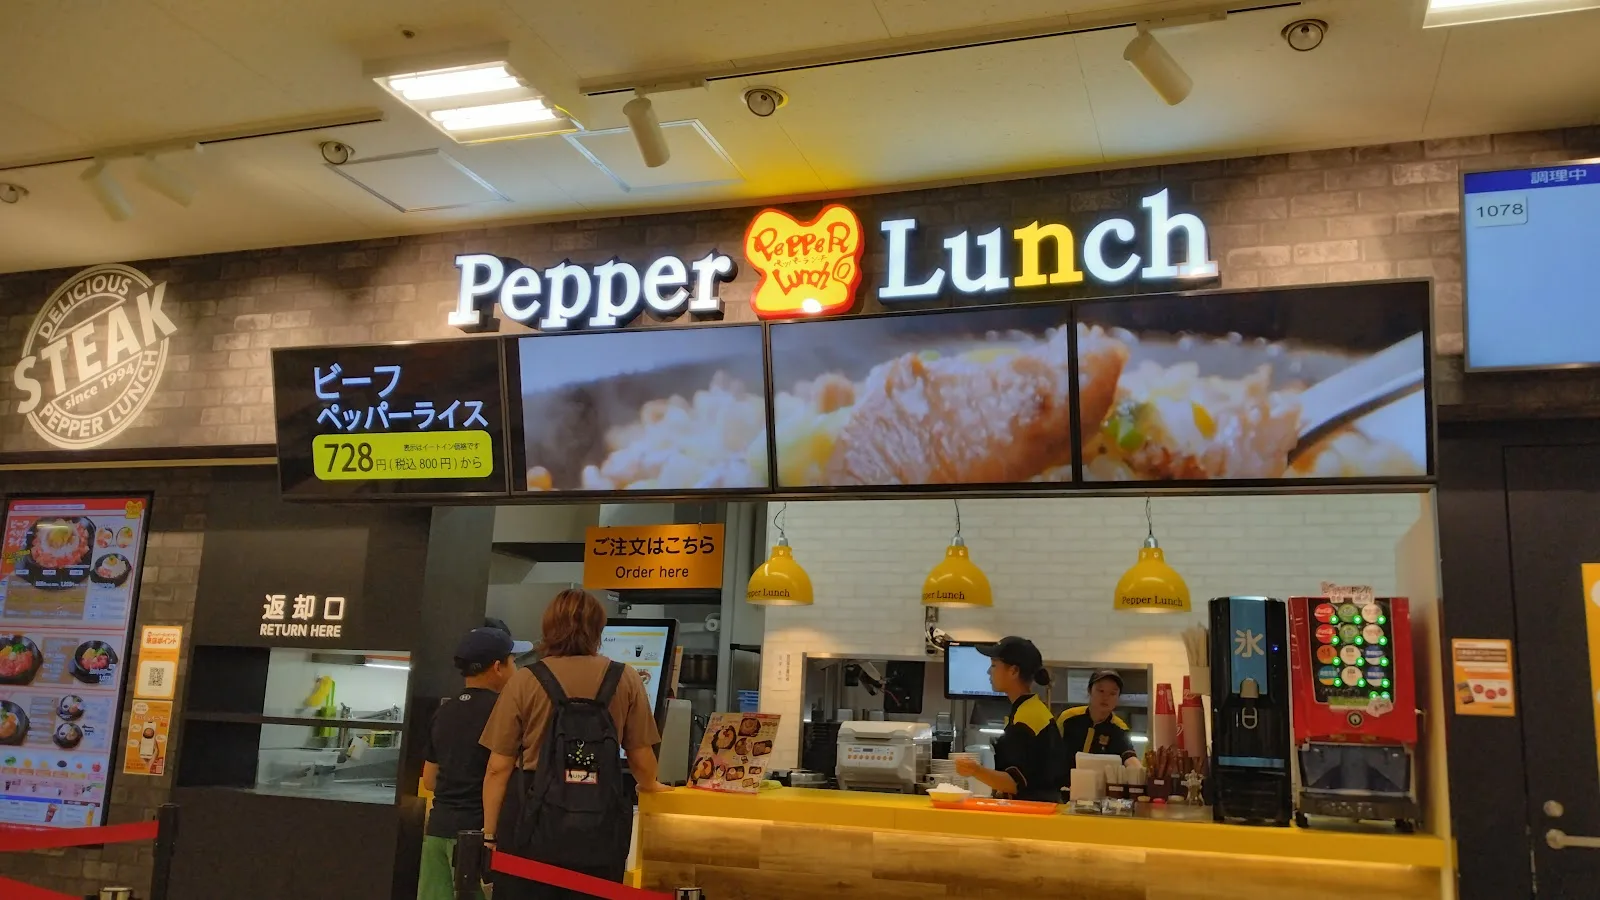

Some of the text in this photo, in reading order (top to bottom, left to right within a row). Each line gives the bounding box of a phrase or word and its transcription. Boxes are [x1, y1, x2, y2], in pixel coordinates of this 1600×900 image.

[1530, 168, 1587, 184] 調理中
[1475, 203, 1524, 218] 1078
[448, 187, 1219, 328] Pepper Lunch
[38, 274, 132, 340] DELICIOUS
[14, 280, 178, 414] STEAK
[65, 362, 135, 410] since 1994
[314, 362, 401, 399] ビーフ
[38, 350, 158, 437] PEPPER LUNCH
[316, 399, 489, 431] ペッパーライス
[403, 442, 480, 452] 表示はイートイン価格です
[593, 536, 715, 556] ご注文はこちら
[615, 566, 689, 579] Order here
[763, 588, 790, 598] Lunch
[937, 590, 965, 600] Lunch
[1122, 595, 1182, 606] Pepper Lunch
[261, 593, 345, 621] 返却口
[260, 623, 341, 637] RETURN HERE
[1234, 628, 1264, 658] 氷
